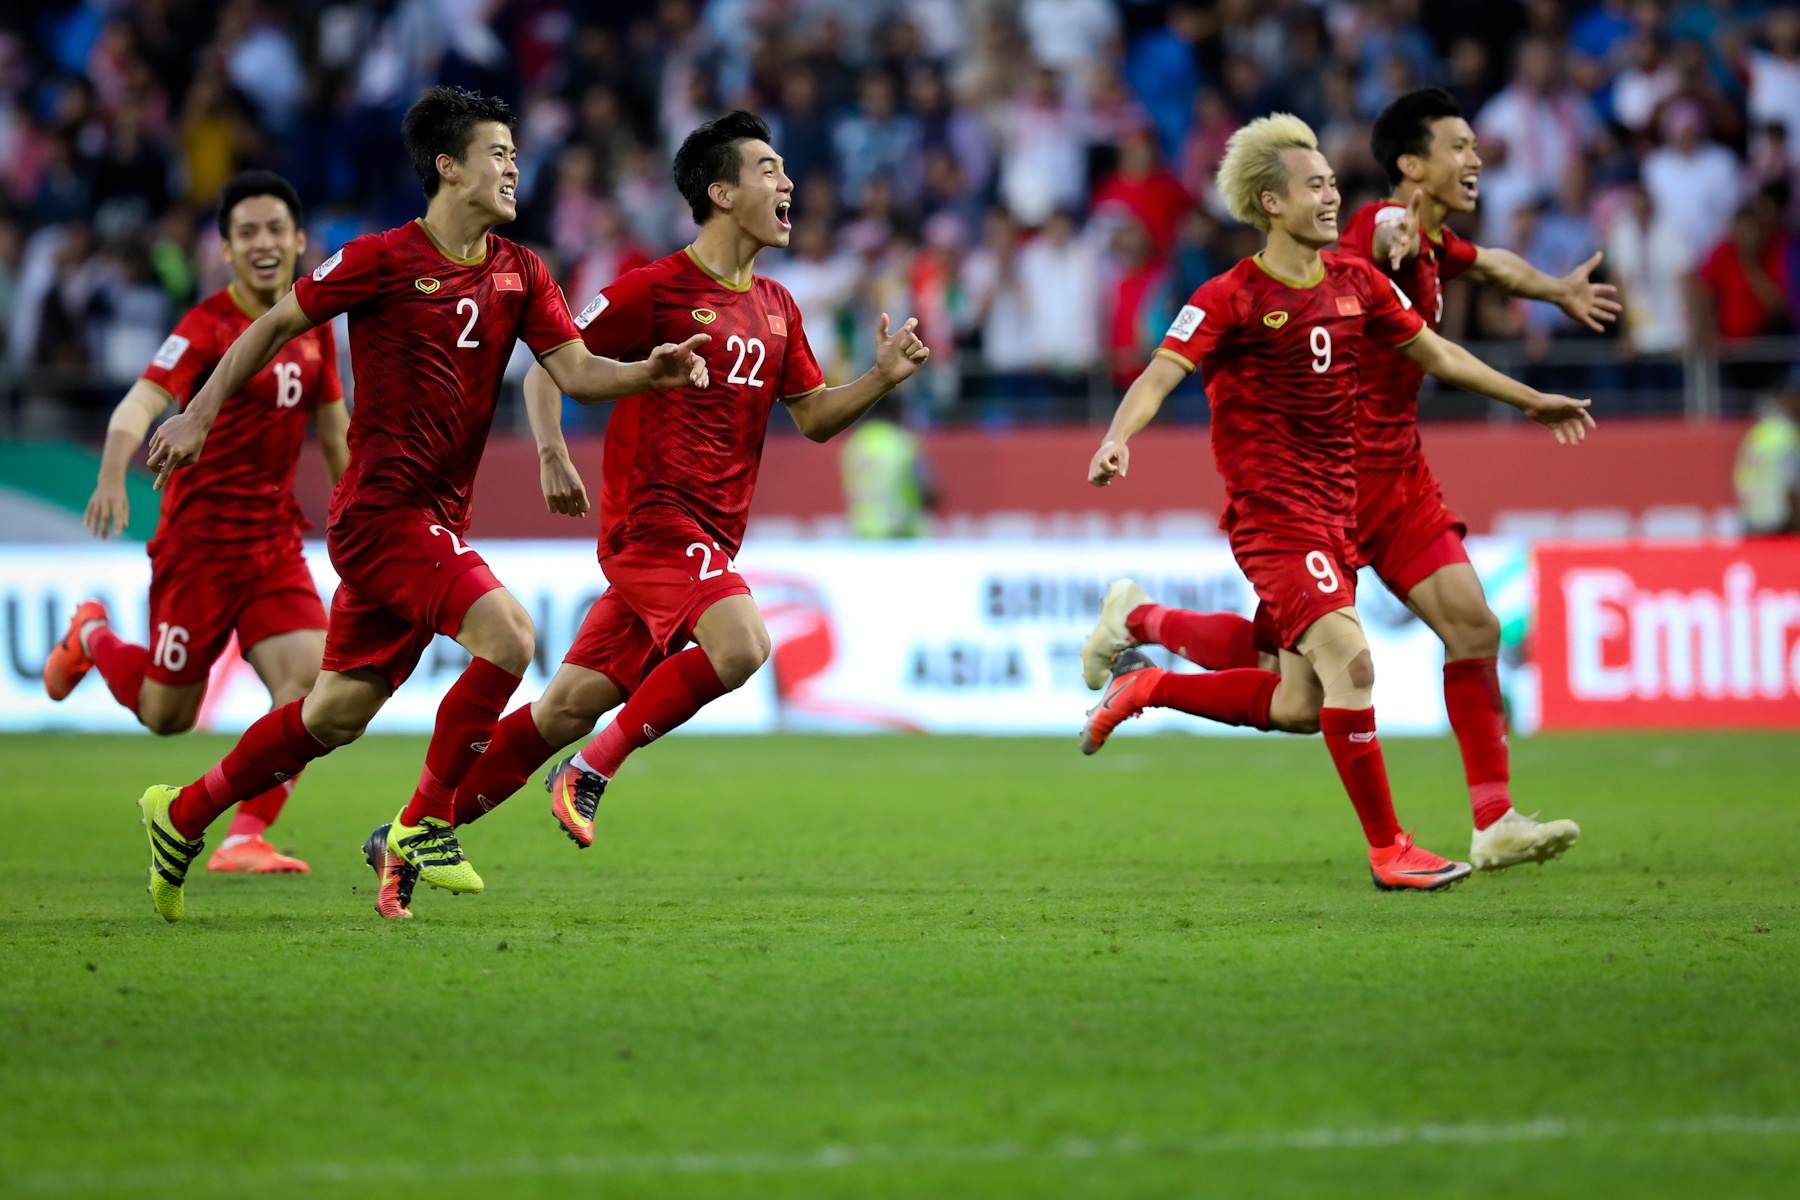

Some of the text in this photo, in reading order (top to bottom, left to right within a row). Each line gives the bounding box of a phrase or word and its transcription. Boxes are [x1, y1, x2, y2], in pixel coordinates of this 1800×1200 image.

[456, 297, 480, 348] 2
[726, 335, 766, 387] 22
[1309, 326, 1332, 374] 9
[273, 361, 303, 408] 16
[429, 524, 474, 556] 2
[686, 541, 740, 581] 2
[1305, 550, 1339, 594] 9
[153, 621, 190, 672] 16
